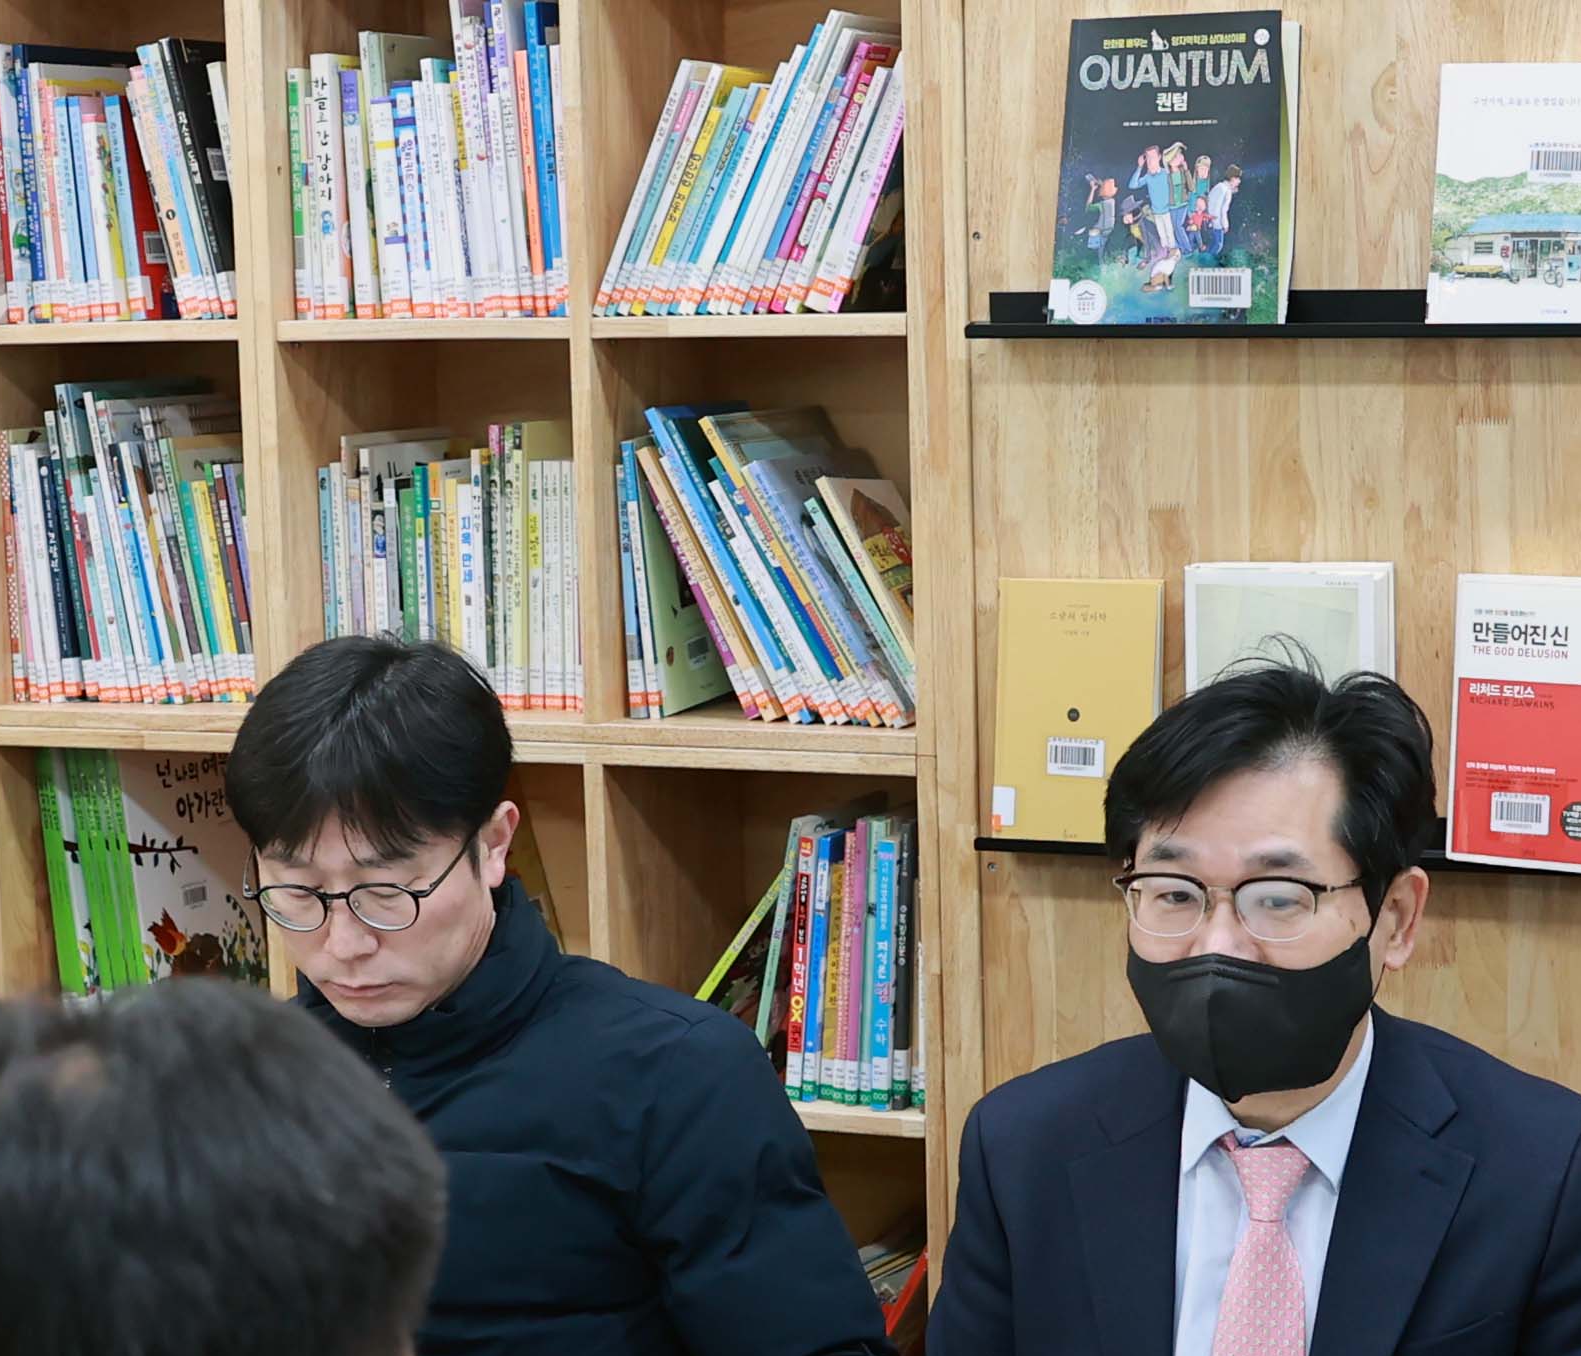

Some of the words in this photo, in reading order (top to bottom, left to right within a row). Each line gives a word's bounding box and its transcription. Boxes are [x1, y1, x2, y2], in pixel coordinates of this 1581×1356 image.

[1079, 49, 1271, 90] QUANTUM
[317, 154, 333, 201] 강아지
[1472, 622, 1547, 647] 만들어진
[1550, 625, 1569, 647] 신
[1472, 645, 1491, 655] THE
[1494, 646, 1514, 657] GOD
[1517, 648, 1569, 660] DELUSION
[1469, 683, 1500, 696] 리처드
[1502, 685, 1535, 699] 도킨스
[1469, 697, 1509, 707] RICHARD
[1513, 698, 1555, 710] DAWKINS
[157, 758, 172, 788] 넌
[175, 762, 199, 783] 나의
[176, 787, 225, 823] 아가란
